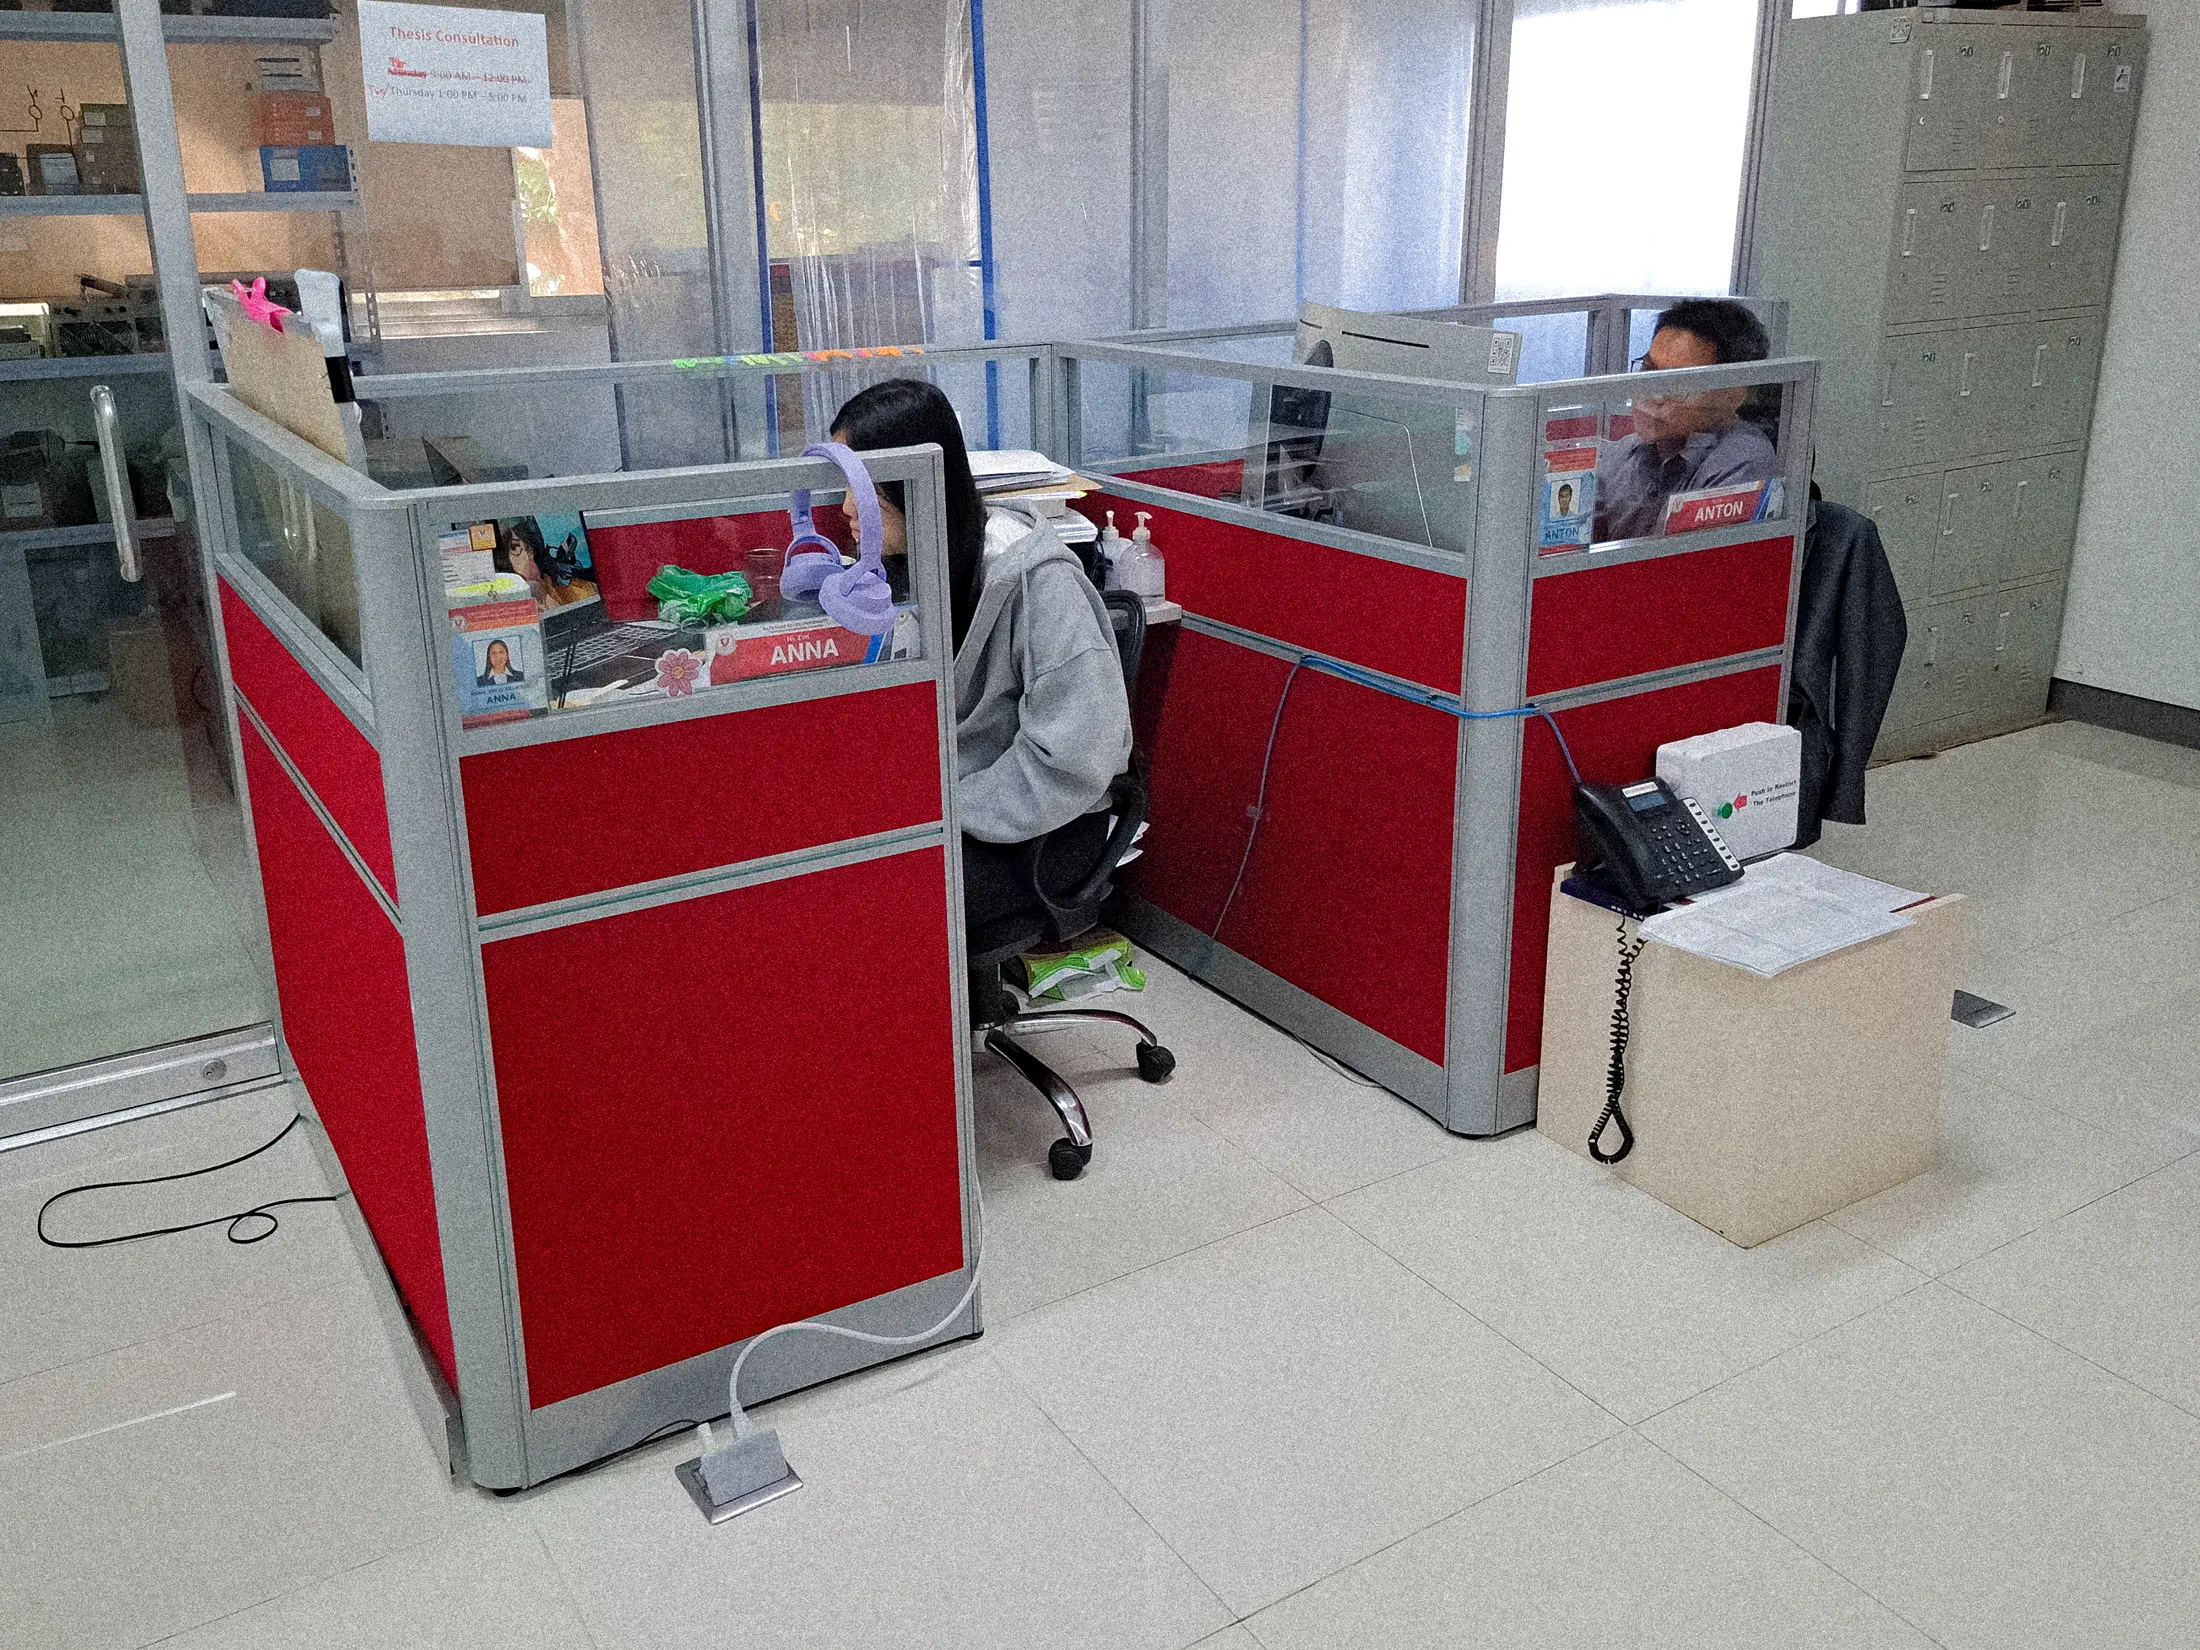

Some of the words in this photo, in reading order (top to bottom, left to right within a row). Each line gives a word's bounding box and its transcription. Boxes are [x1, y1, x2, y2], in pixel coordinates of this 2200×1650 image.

[389, 26, 432, 41] Thesis
[435, 30, 519, 47] Consultation
[454, 71, 471, 80] AM
[483, 72, 509, 83] 12:00
[511, 75, 527, 84] PM
[391, 86, 435, 99] Thursday
[439, 89, 459, 99] 1:00
[461, 90, 477, 100] PM
[488, 92, 509, 102] 5:00
[511, 93, 527, 103] PM
[1694, 500, 1744, 522] ANTON
[1544, 527, 1580, 541] ANTON
[770, 638, 839, 666] ANNA
[486, 692, 517, 705] ANNA
[1750, 788, 1766, 797] Push
[1766, 785, 1773, 793] to
[1774, 779, 1797, 790] Restart
[1753, 799, 1764, 807] The
